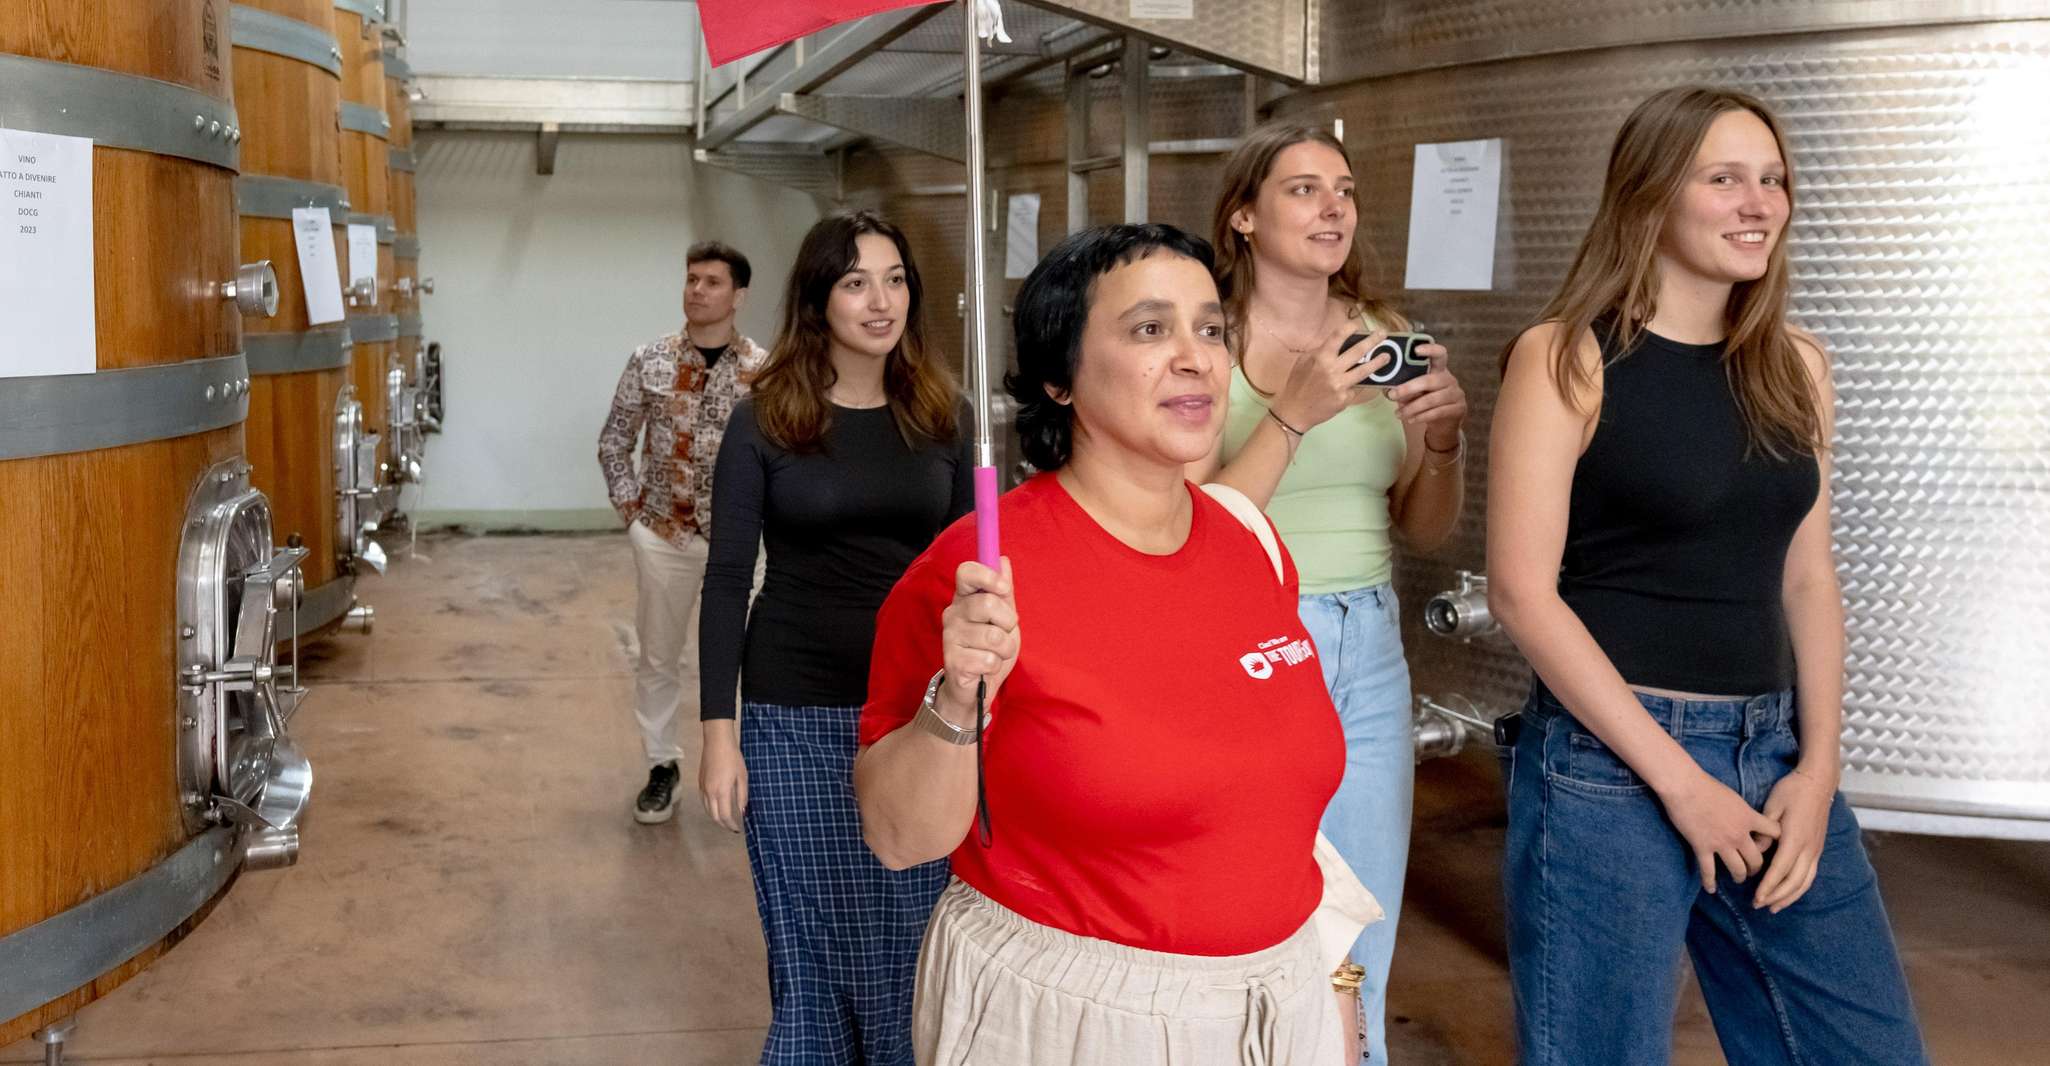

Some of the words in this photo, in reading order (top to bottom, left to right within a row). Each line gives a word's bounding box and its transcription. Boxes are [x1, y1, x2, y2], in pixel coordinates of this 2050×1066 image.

[18, 155, 37, 164] VINO
[19, 172, 24, 180] A
[25, 173, 57, 183] DIVENIRE
[14, 190, 42, 199] CHIANTI
[18, 208, 39, 217] DOCG
[20, 225, 37, 234] 2023
